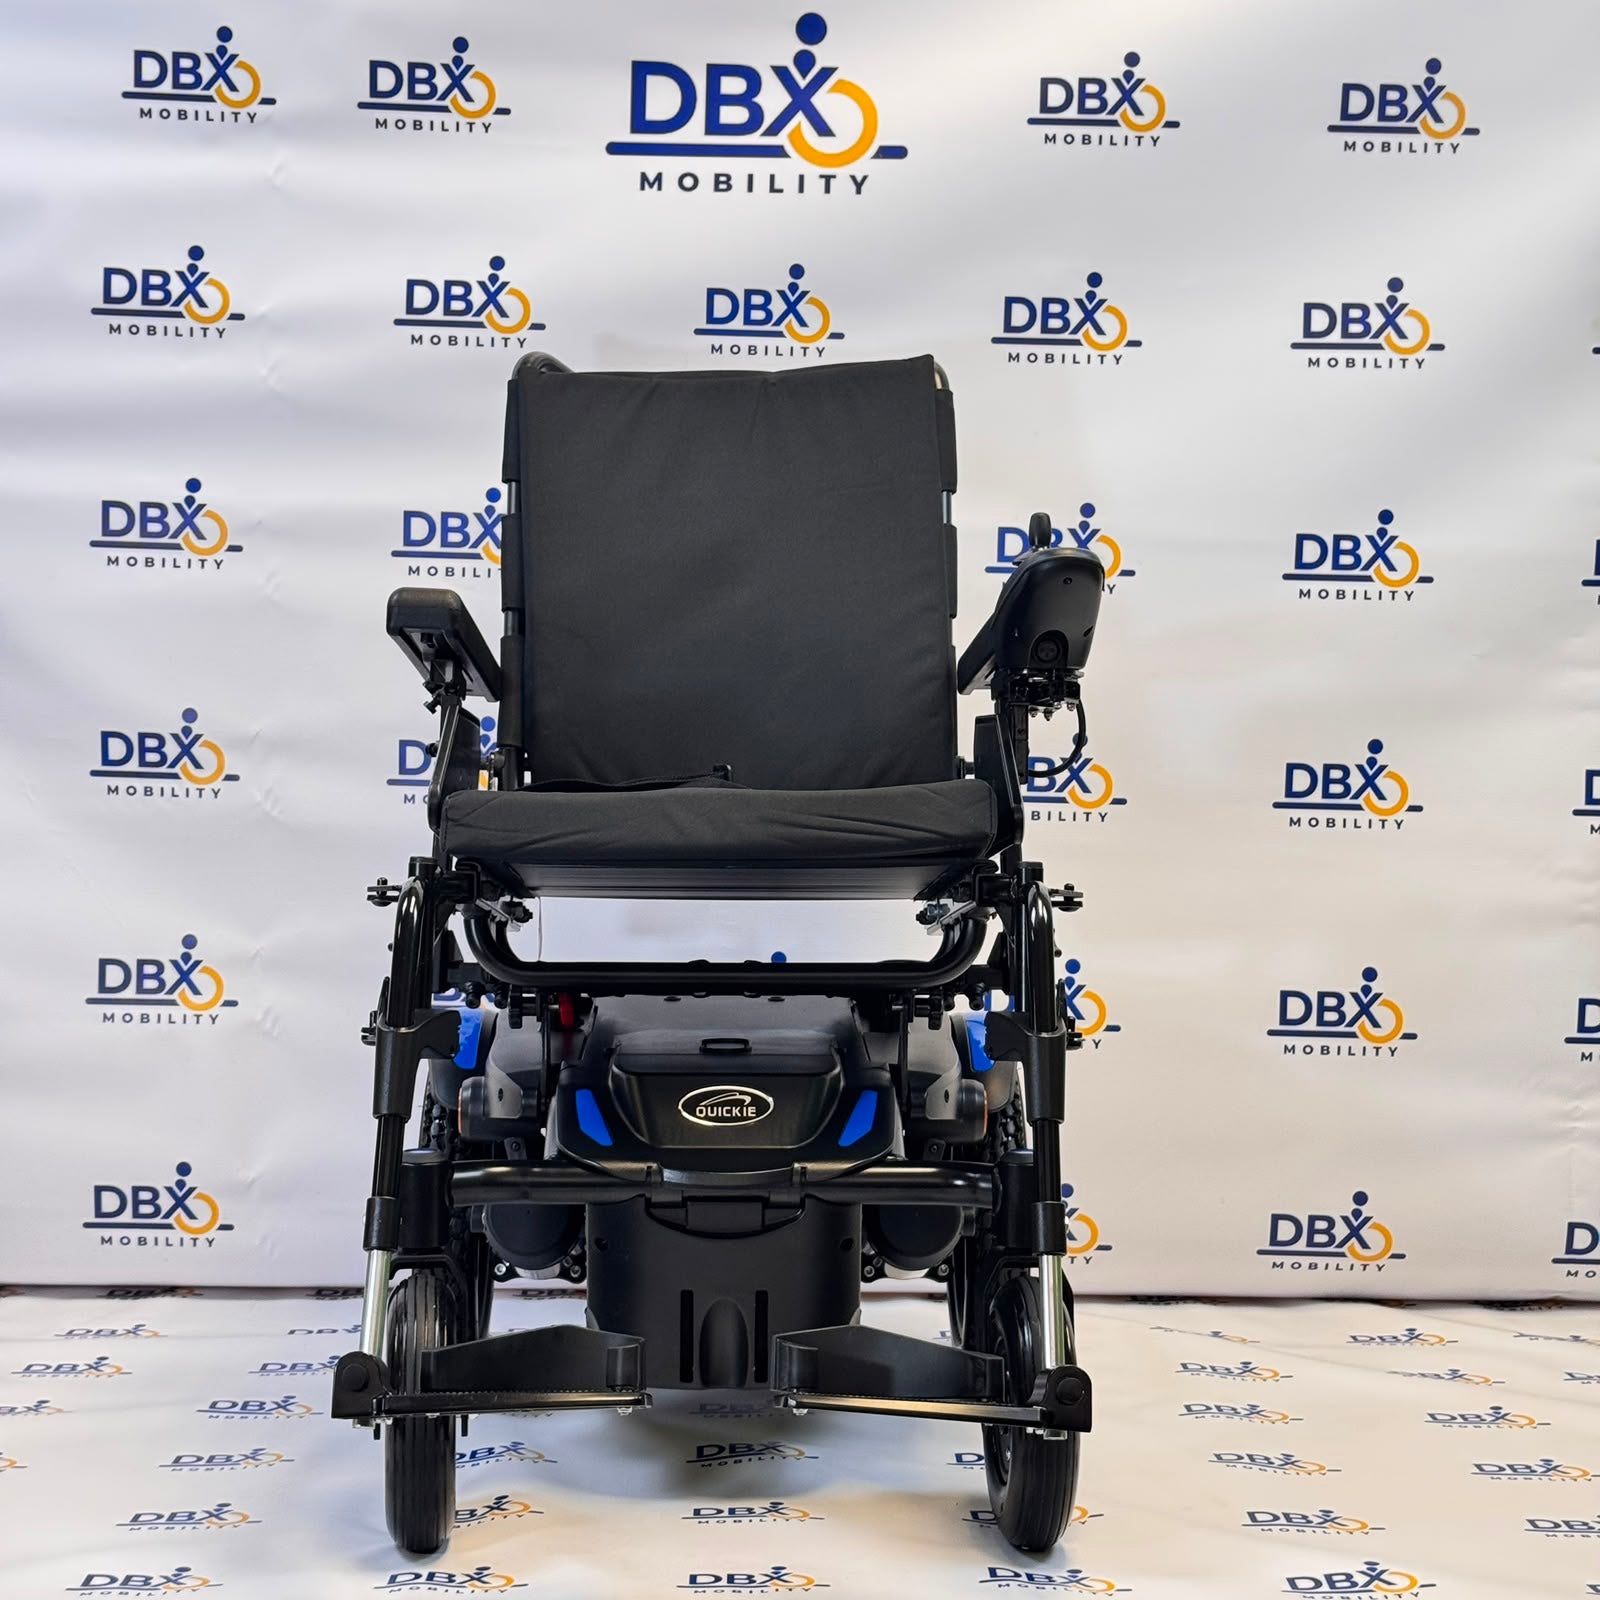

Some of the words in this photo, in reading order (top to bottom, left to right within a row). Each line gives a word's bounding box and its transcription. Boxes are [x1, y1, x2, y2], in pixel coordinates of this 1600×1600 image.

[133, 50, 238, 92] DBX
[369, 60, 475, 103] DBX
[630, 61, 839, 137] DBX
[1040, 77, 1146, 116] DBX
[1339, 83, 1446, 124] DBX
[140, 108, 256, 124] MOBILITY
[376, 118, 492, 134] MOBILITY
[1044, 134, 1160, 146] MOBILITY
[1344, 140, 1460, 154] MOBILITY
[640, 172, 868, 196] MOBILITY
[102, 268, 208, 309] DBX
[405, 279, 510, 319] DBX
[706, 287, 810, 327] DBX
[1003, 296, 1108, 335] DBX
[1303, 302, 1409, 341] DBX
[108, 324, 226, 338] MOBILITY
[410, 334, 526, 348] MOBILITY
[710, 344, 826, 358] MOBILITY
[1008, 352, 1122, 364] MOBILITY
[1308, 358, 1424, 370] MOBILITY
[102, 499, 206, 539] DBX
[403, 510, 501, 549] DBX
[1294, 533, 1398, 572] DBX
[106, 556, 224, 570] MOBILITY
[408, 565, 501, 578] MOBILI
[1298, 588, 1414, 602] MOBILITY
[100, 731, 203, 769] DBX
[1284, 762, 1388, 800] DBX
[108, 784, 220, 798] MOBILITY
[1032, 810, 1108, 822] BILITY
[1290, 816, 1404, 830] MOBILITY
[98, 958, 203, 996] DBX
[1278, 990, 1384, 1029] DBX
[102, 1012, 218, 1024] MOBILITY
[1284, 1044, 1398, 1058] MOBILITY
[696, 1106, 756, 1117] QUICKIE
[94, 1185, 199, 1219] DBX
[1268, 1213, 1374, 1249] DBX
[100, 1236, 214, 1248] MOBILITY
[1272, 1262, 1386, 1272] MOBILITY
[1349, 1333, 1425, 1343] DBX
[22, 1364, 111, 1373] DBX
[1181, 1362, 1263, 1375] DBX
[209, 1400, 298, 1412] DBX
[1184, 1404, 1271, 1418] DBX
[1427, 1412, 1519, 1422] DBX
[696, 1442, 788, 1458] DBX
[172, 1454, 265, 1462] DBX
[1213, 1453, 1308, 1469] DBX
[1473, 1464, 1572, 1475] DBX
[130, 1509, 234, 1522] DBX
[693, 1507, 789, 1516] DBX
[1247, 1511, 1348, 1527] DBX
[80, 1574, 191, 1588] DBX
[388, 1572, 494, 1584] DBX
[689, 1572, 792, 1585] DBX
[988, 1567, 1092, 1588] DBX
[1286, 1569, 1398, 1590] DBX
[389, 1586, 509, 1594] MOBILITY
